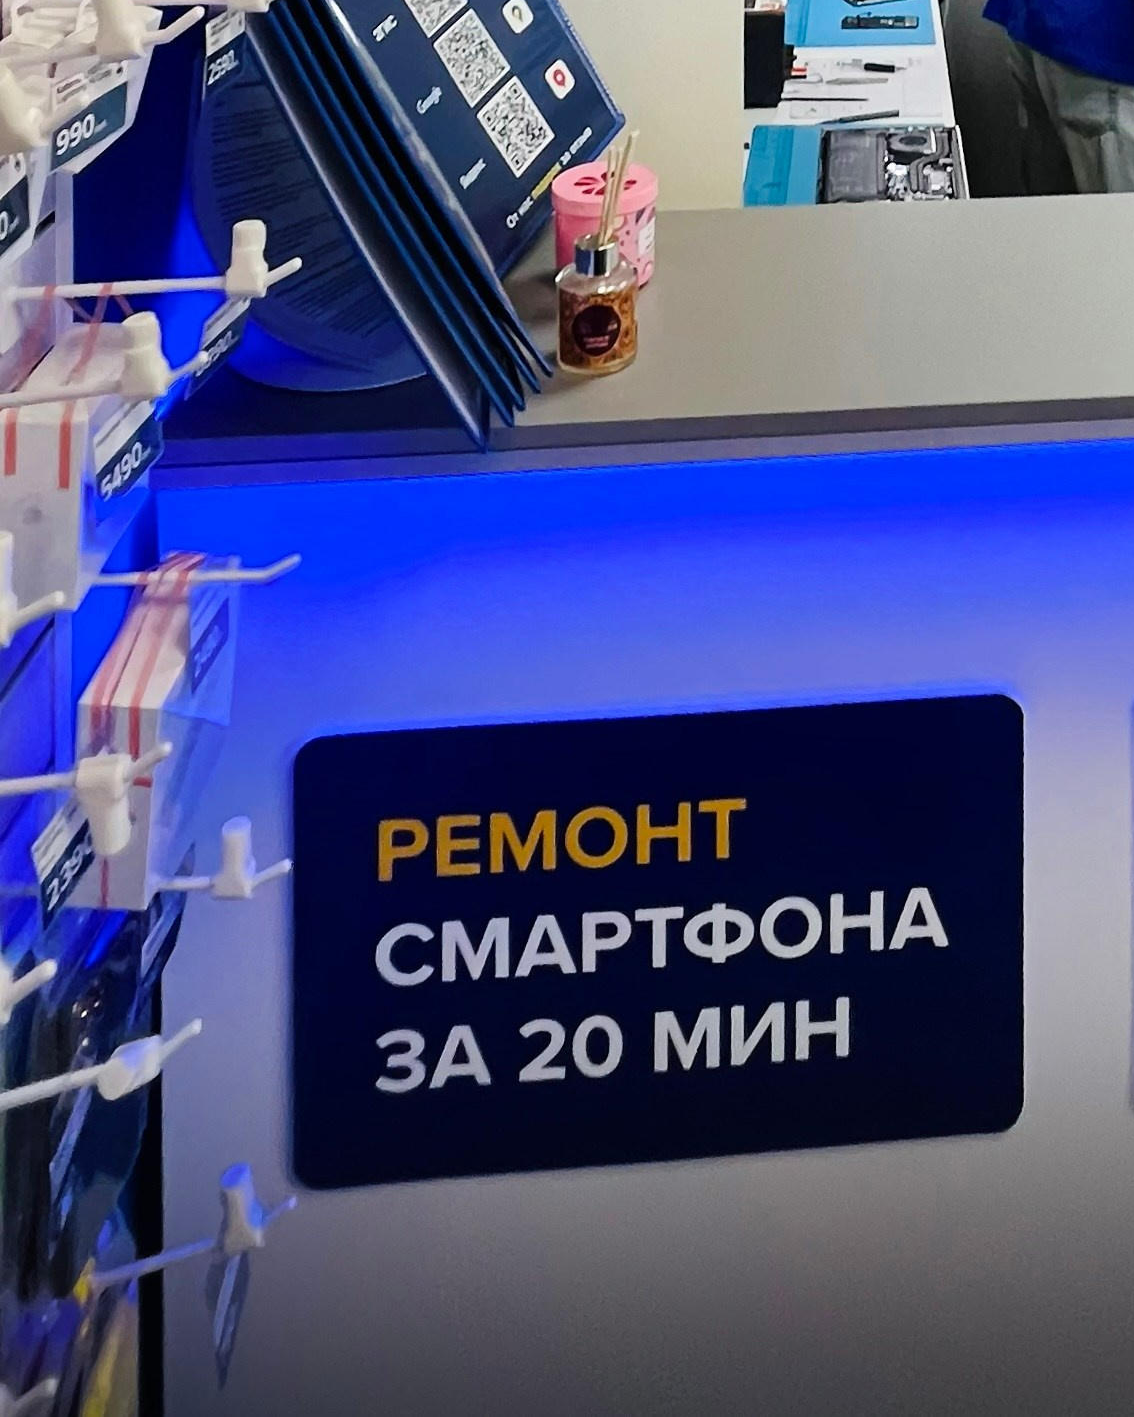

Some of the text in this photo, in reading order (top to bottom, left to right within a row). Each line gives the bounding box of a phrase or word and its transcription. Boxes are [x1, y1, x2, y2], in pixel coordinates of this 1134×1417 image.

[377, 796, 748, 882] РЕМОНТ
[374, 886, 950, 987] СМАРТФОНА
[374, 996, 851, 1094] ЗА 20 МИН
